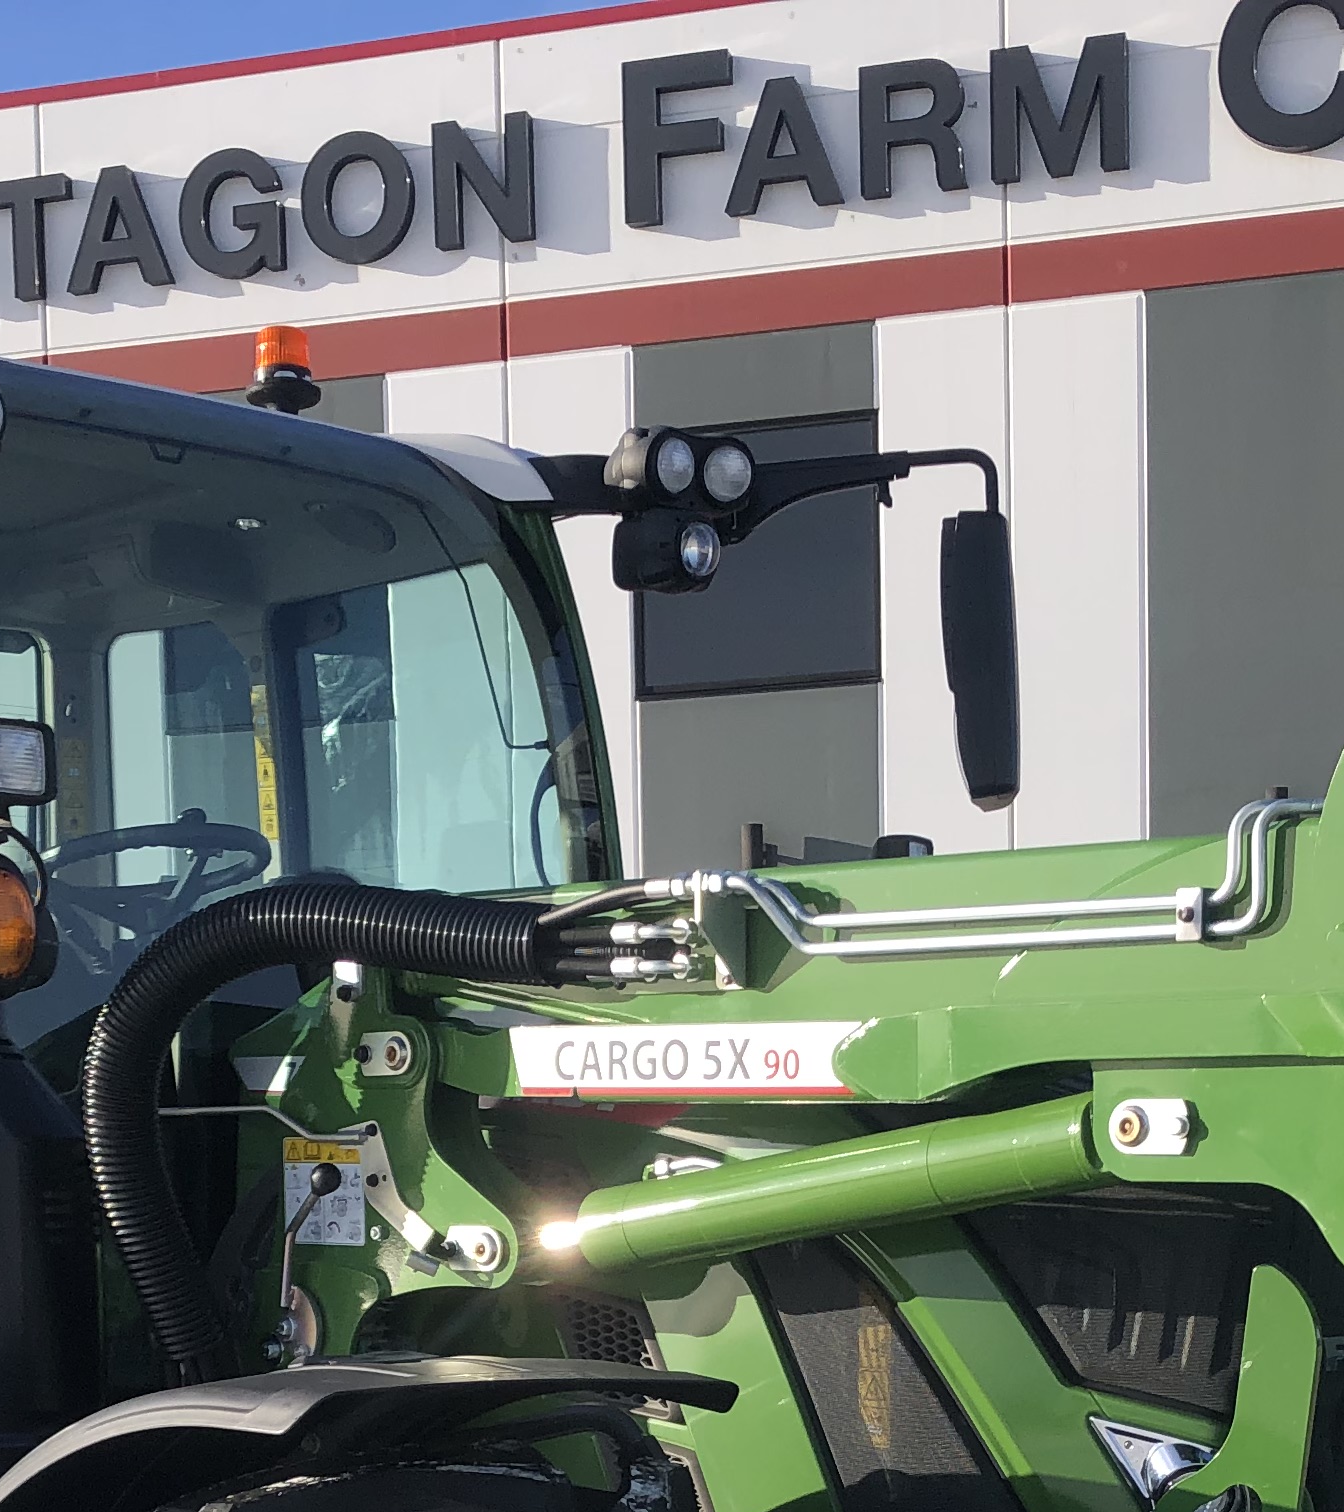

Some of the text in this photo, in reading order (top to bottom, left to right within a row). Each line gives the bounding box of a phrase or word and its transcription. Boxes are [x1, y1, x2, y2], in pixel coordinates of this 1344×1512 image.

[621, 32, 1130, 229] FARM
[554, 1038, 800, 1081] CARGO 5X 90
